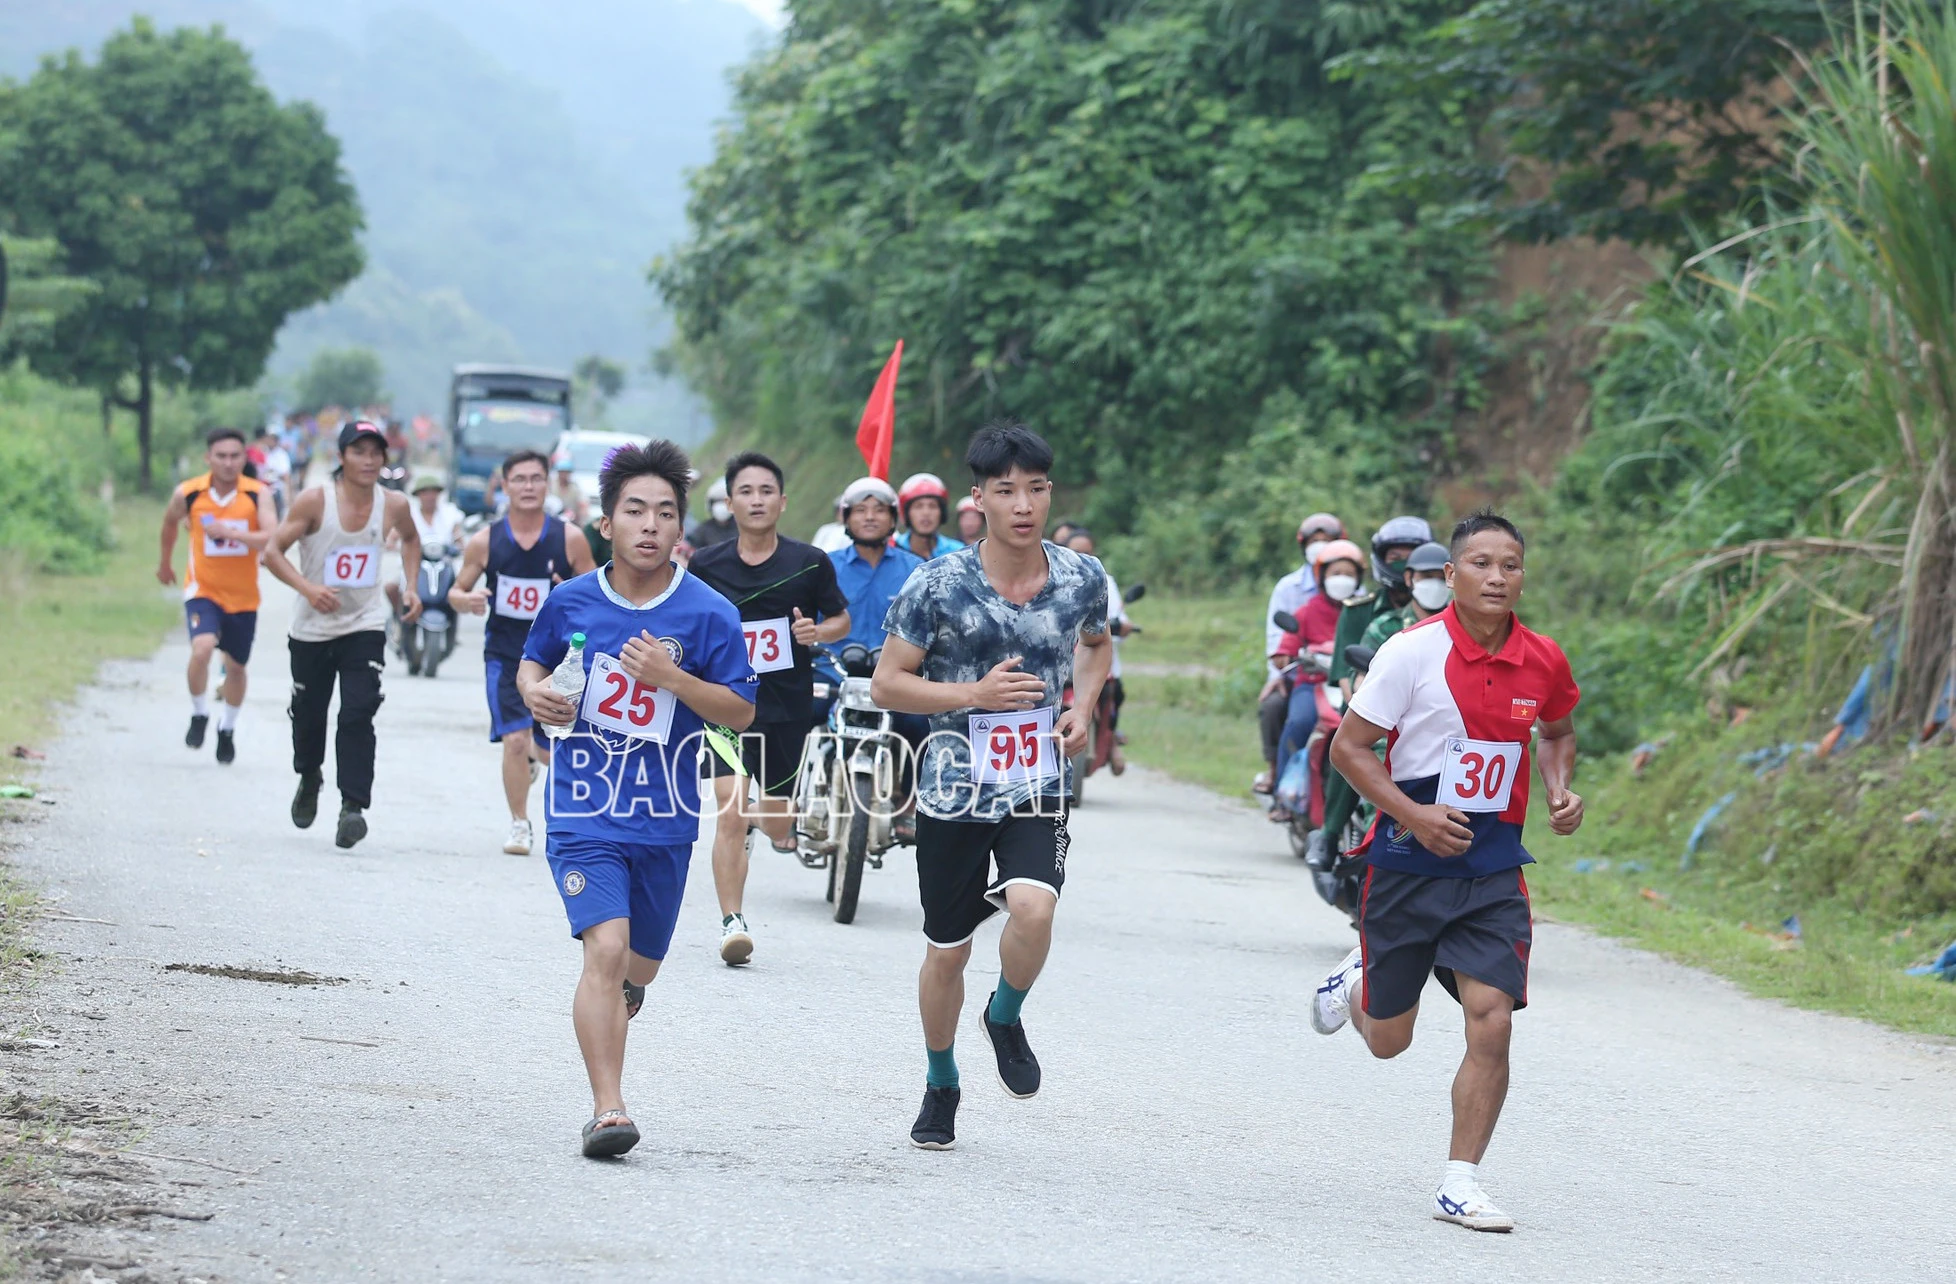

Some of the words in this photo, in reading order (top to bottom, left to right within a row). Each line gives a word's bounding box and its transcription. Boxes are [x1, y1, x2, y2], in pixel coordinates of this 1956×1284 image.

[336, 554, 369, 580] 67
[507, 586, 539, 612] 49
[743, 629, 780, 662] 73
[598, 672, 656, 727] 25
[990, 722, 1039, 772] 95
[1455, 752, 1506, 800] 30
